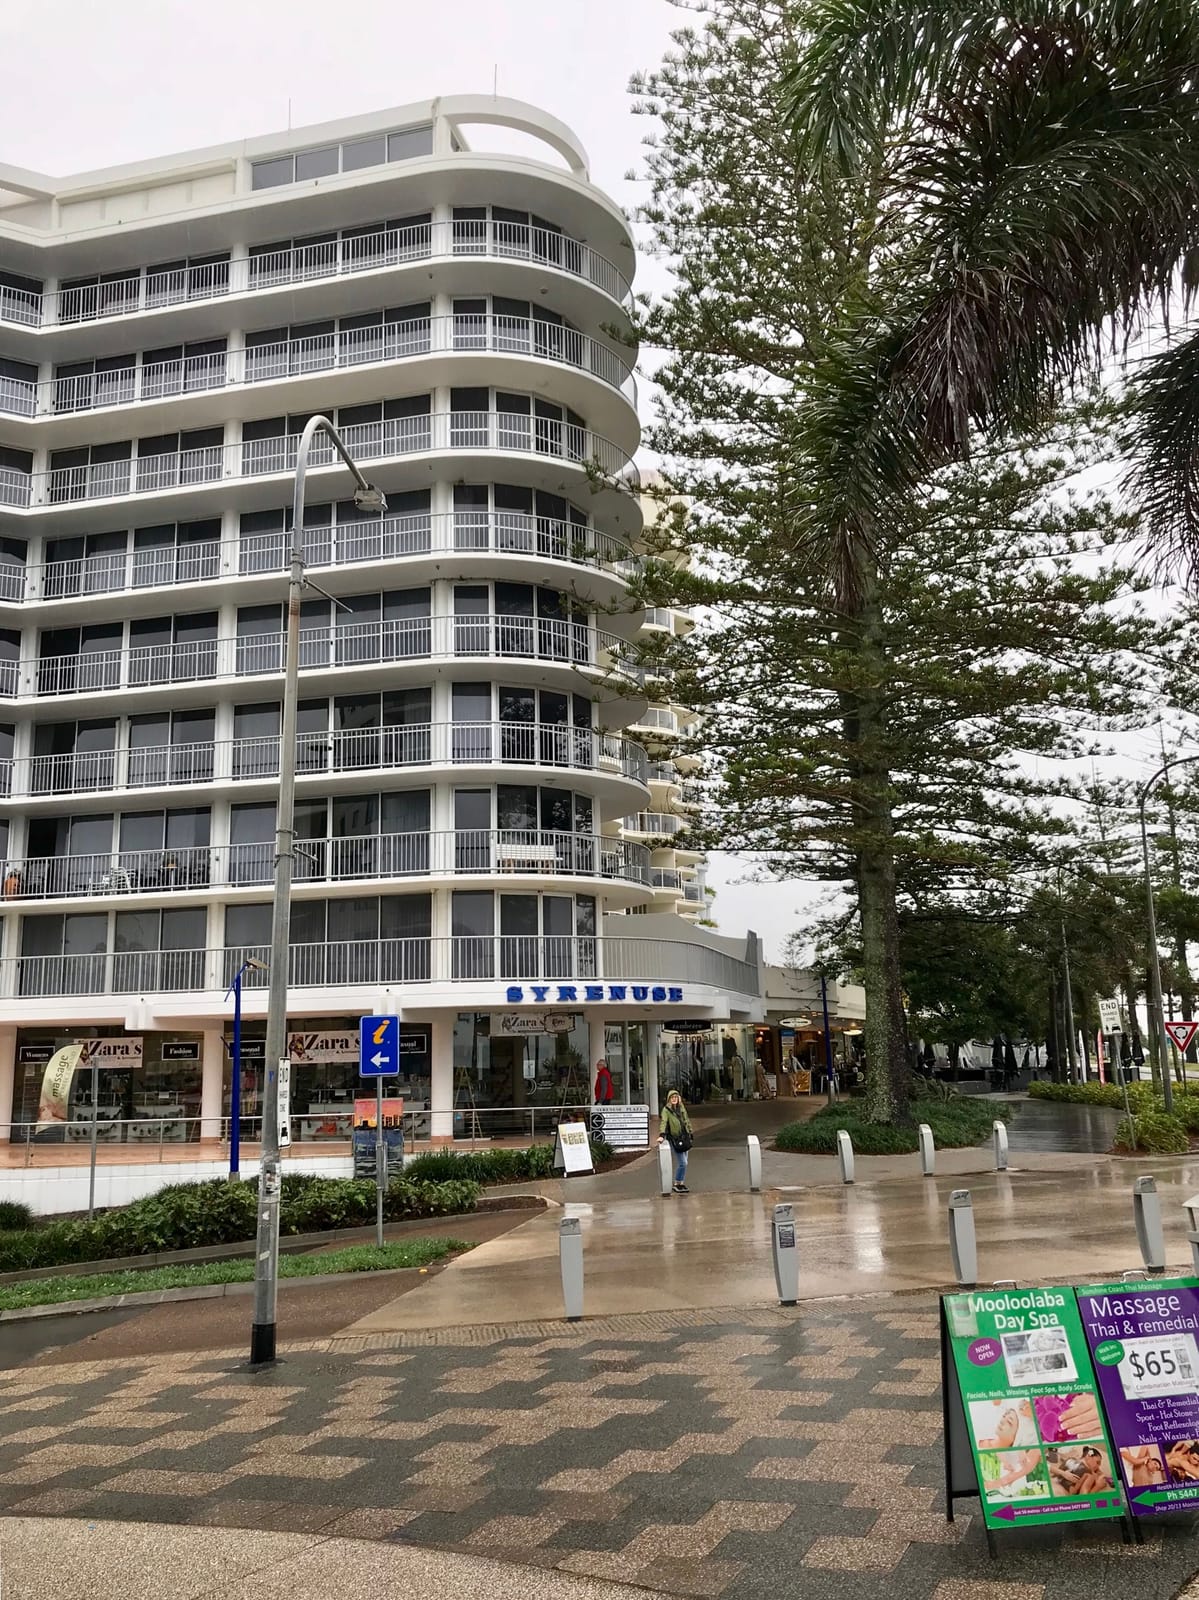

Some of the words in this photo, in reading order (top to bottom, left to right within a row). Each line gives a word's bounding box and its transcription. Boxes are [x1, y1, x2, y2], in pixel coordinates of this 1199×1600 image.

[506, 985, 683, 1003] SYRENUSE
[1100, 1002, 1117, 1011] END
[88, 1040, 142, 1057] Zara's
[169, 1047, 193, 1055] Fashion
[52, 1055, 69, 1098] massage
[971, 1291, 1065, 1313] Mooloolaba
[1089, 1295, 1181, 1318] Massage
[994, 1314, 1025, 1331] Day
[1028, 1311, 1059, 1329] Spa
[1088, 1321, 1120, 1337] Thai
[1123, 1320, 1135, 1335] &
[1137, 1313, 1199, 1333] remedial
[975, 1343, 991, 1353] NOW
[978, 1350, 995, 1361] OPEN
[1128, 1350, 1176, 1381] $65
[1058, 1384, 1072, 1392] Body
[1073, 1383, 1093, 1391] Scrubs
[1141, 1401, 1157, 1410] Thai
[1135, 1412, 1155, 1423] Sport
[1159, 1410, 1173, 1419] Hot
[1173, 1408, 1193, 1418] Stone
[1147, 1422, 1163, 1431] Foot
[1138, 1433, 1157, 1444] Nails
[1161, 1431, 1191, 1442] Waxing
[1166, 1490, 1178, 1501] Ph
